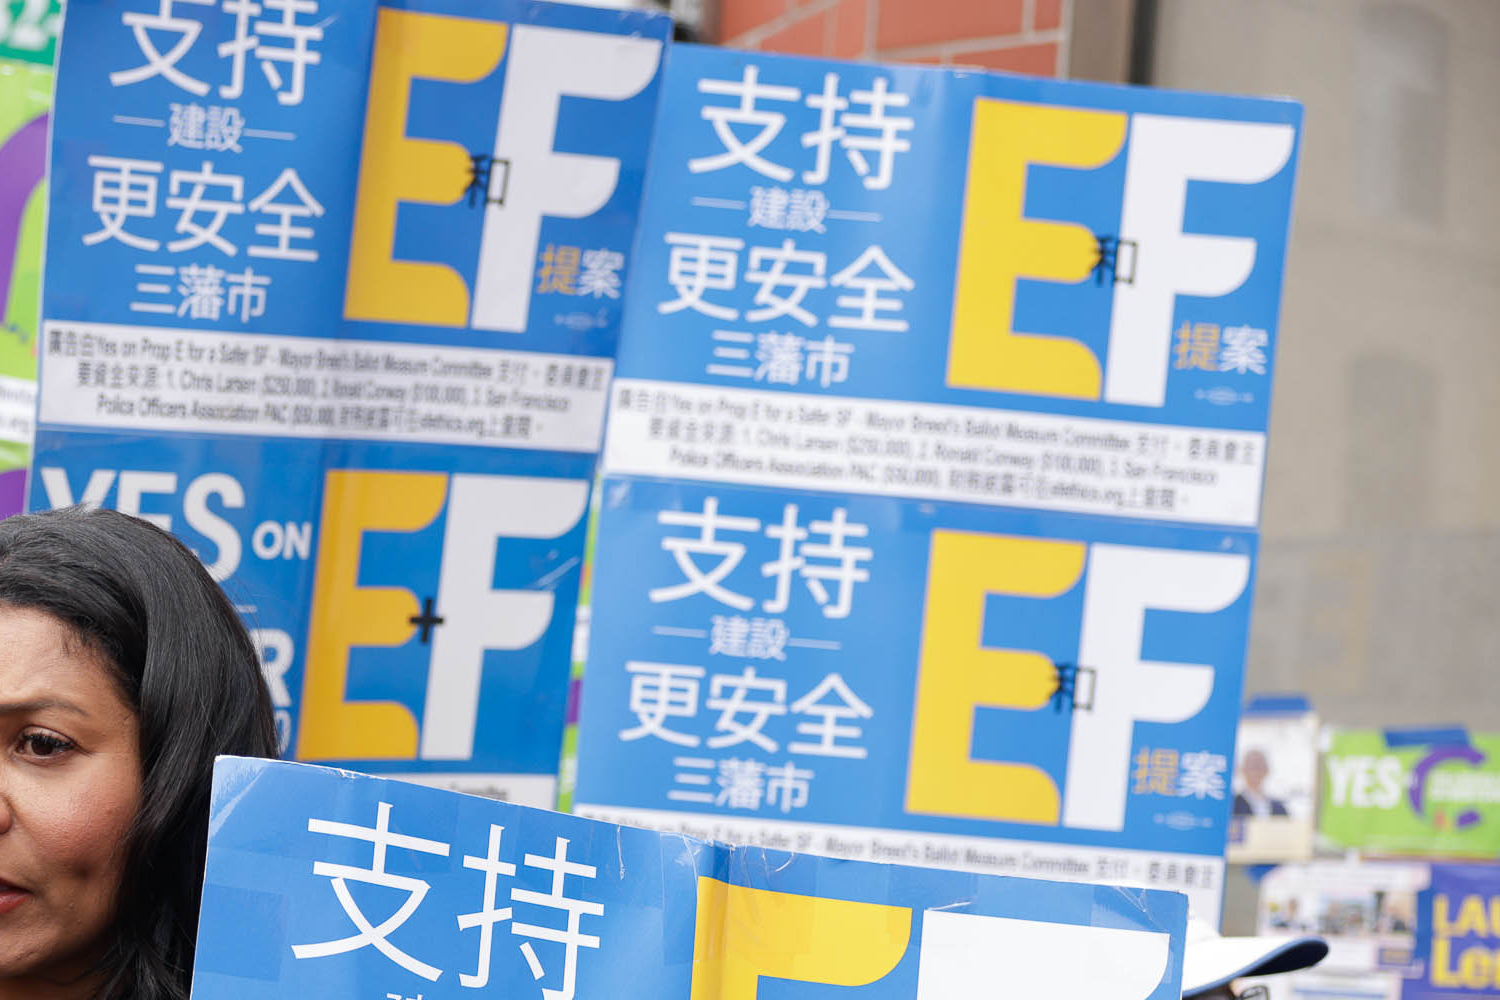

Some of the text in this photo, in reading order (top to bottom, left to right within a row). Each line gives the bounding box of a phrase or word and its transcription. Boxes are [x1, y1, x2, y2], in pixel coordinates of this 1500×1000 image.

[167, 103, 245, 153] 建設
[688, 64, 915, 190] 支持
[82, 155, 325, 261] 更安全
[747, 185, 830, 234] 建設
[130, 264, 271, 324] 三藩市
[538, 244, 625, 300] 提案
[657, 231, 915, 332] 更安全
[705, 329, 856, 389] 三藩市
[1174, 319, 1269, 376] 提案
[252, 520, 313, 560] ON
[648, 496, 874, 619] 支持
[296, 468, 450, 762] E
[419, 472, 591, 761] F
[709, 615, 790, 662] 建設
[619, 659, 874, 760] 更安全
[667, 755, 815, 814] 三藩市
[1129, 745, 1229, 801] 提案
[1327, 753, 1403, 811] YES
